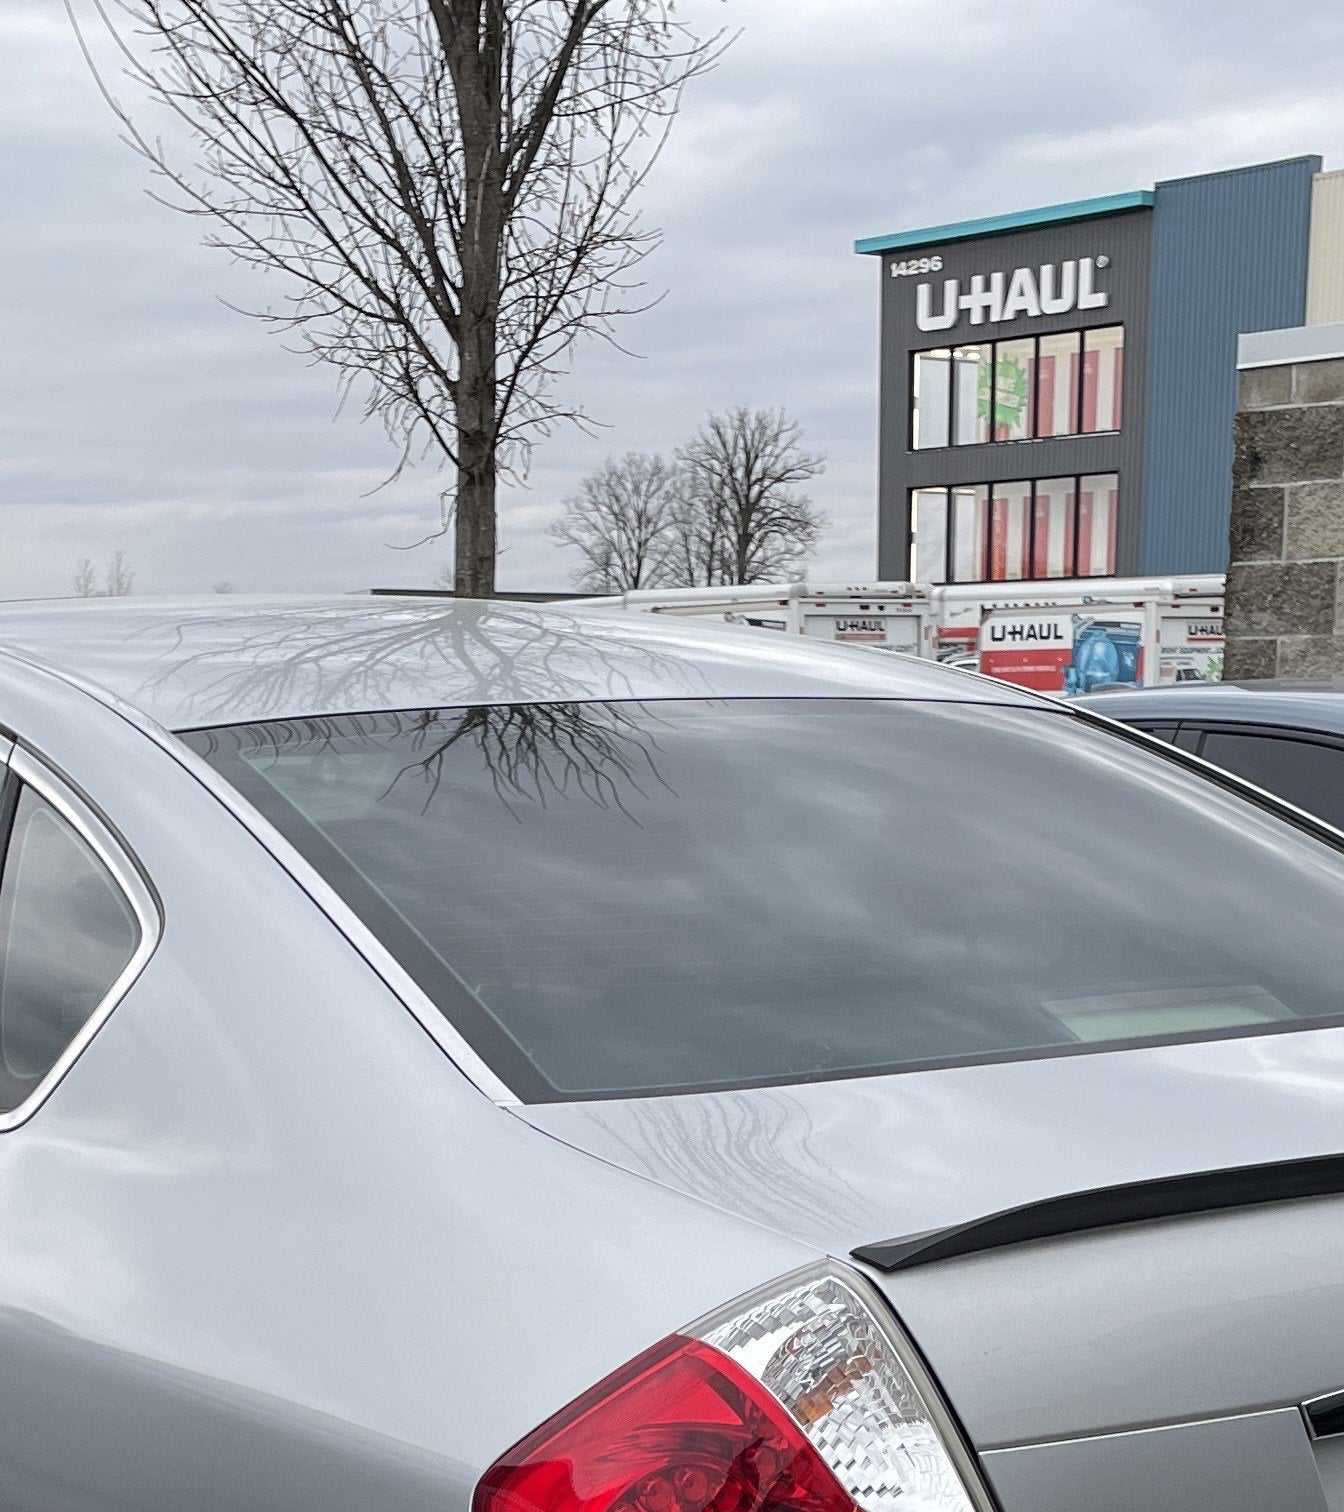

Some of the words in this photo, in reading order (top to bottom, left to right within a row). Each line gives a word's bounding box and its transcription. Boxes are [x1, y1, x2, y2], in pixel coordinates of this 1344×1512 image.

[890, 256, 943, 278] 14296
[916, 256, 1108, 332] U-HAUL
[991, 622, 1064, 642] U-HAUL
